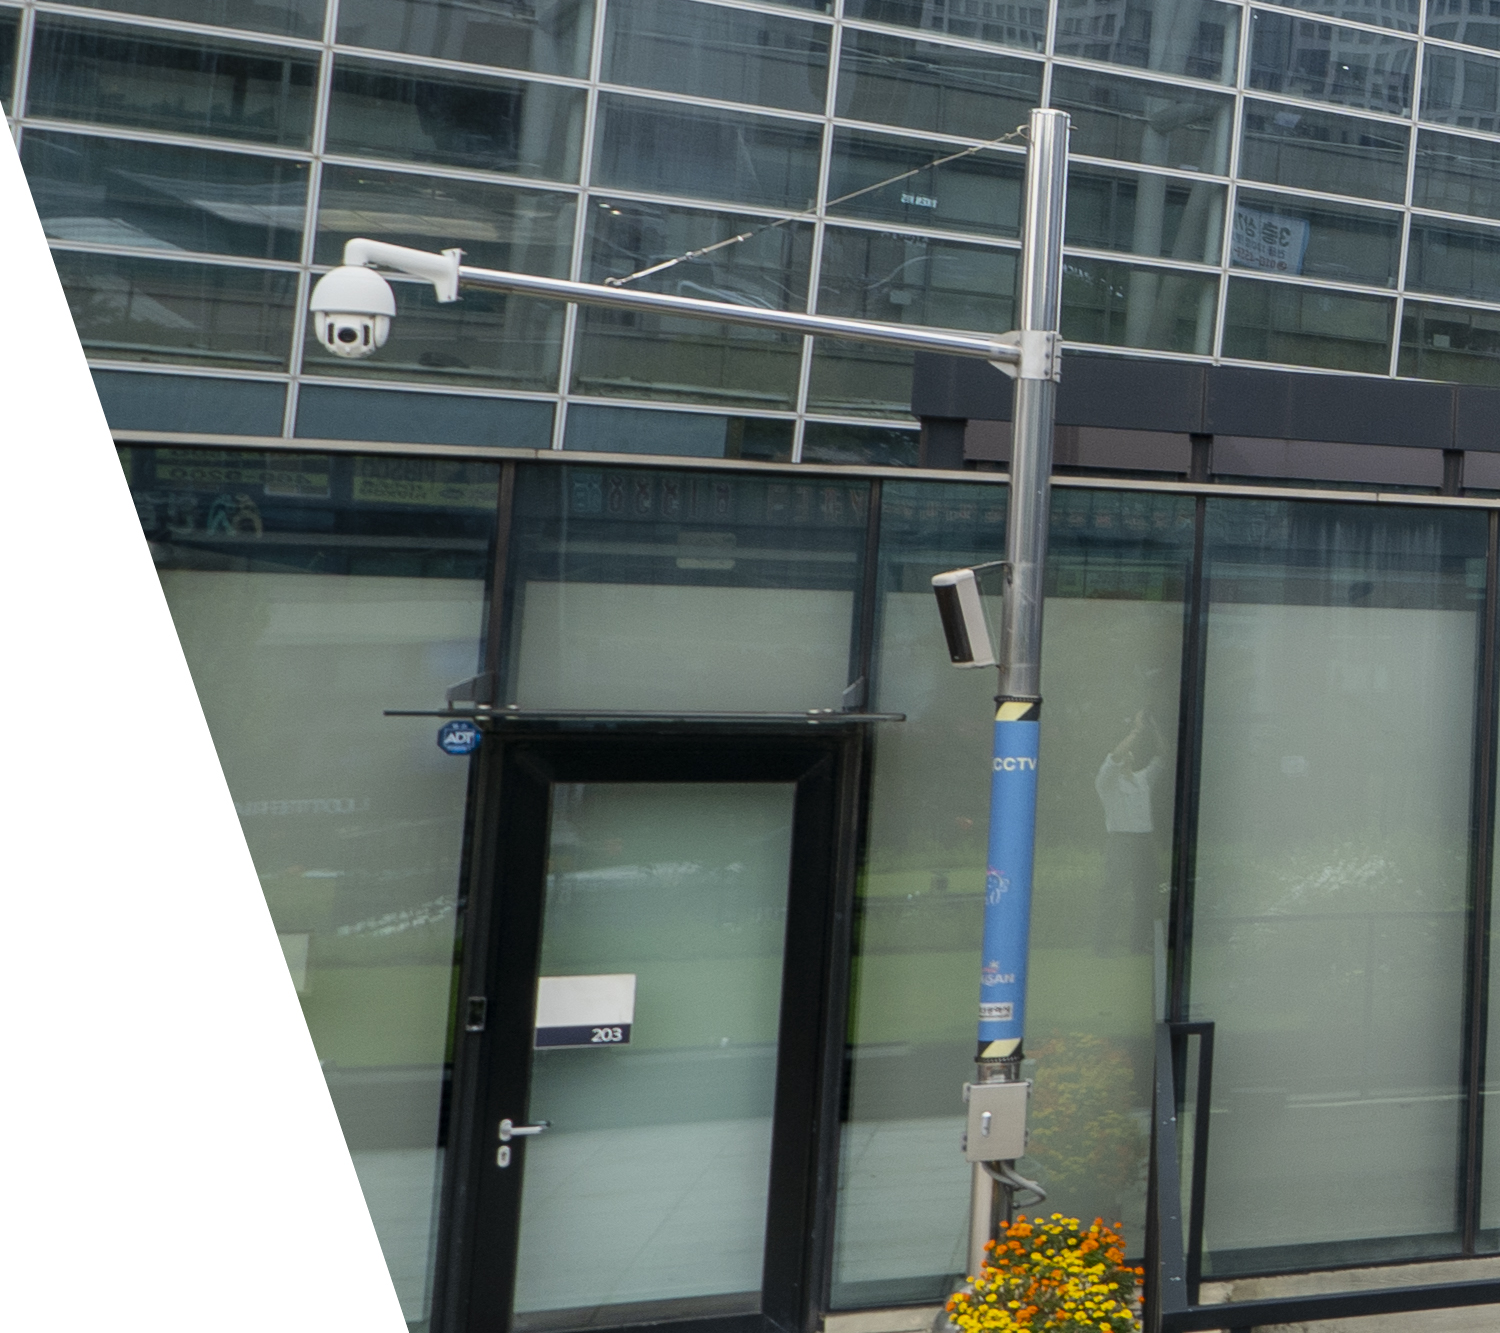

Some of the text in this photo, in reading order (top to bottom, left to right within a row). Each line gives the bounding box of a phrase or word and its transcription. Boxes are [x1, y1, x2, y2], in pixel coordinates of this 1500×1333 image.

[443, 732, 474, 745] ADT
[991, 757, 1038, 771] CCTV
[591, 1027, 623, 1043] 203
